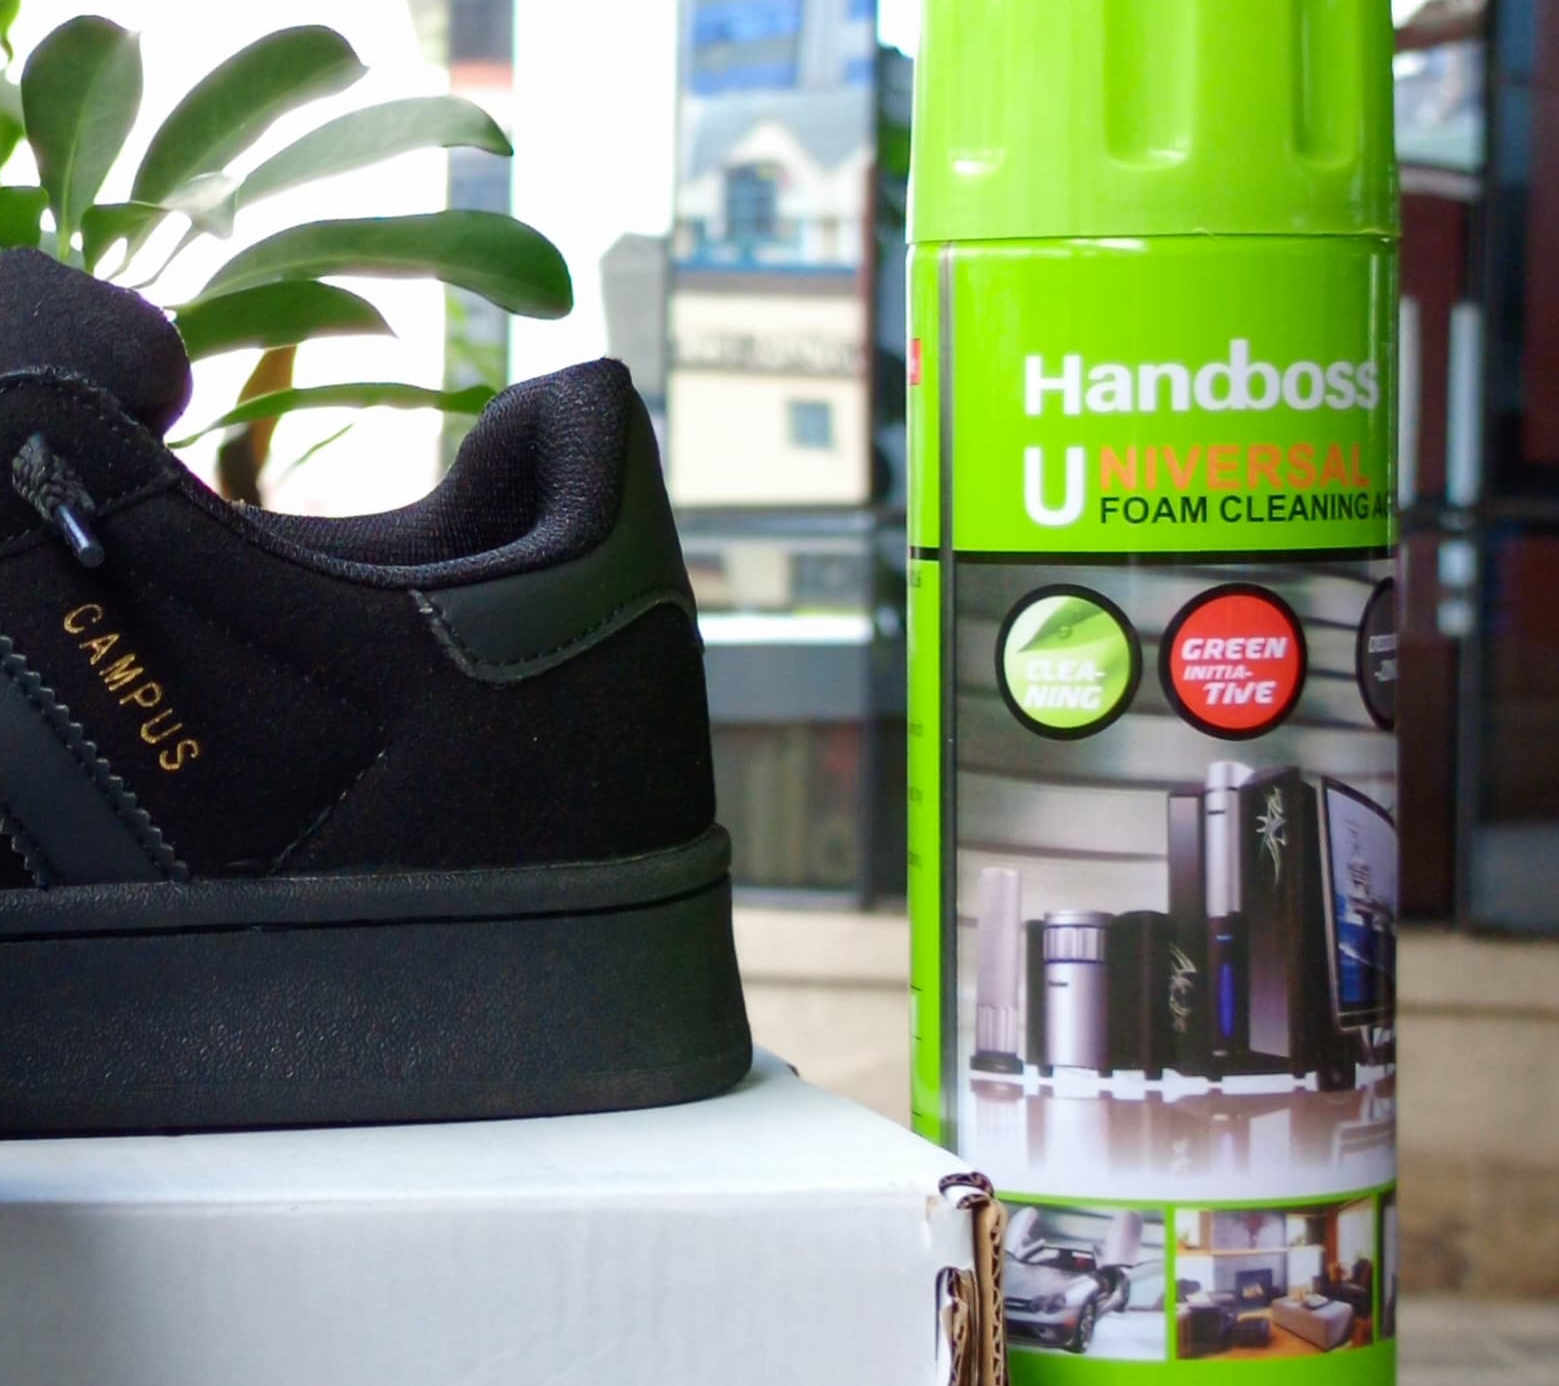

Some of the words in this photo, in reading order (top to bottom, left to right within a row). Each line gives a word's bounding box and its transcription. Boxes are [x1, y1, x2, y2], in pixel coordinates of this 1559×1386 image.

[1024, 338, 1381, 417] Handboss
[1099, 496, 1209, 525] FOAM
[1218, 491, 1370, 523] CLEANING
[1180, 636, 1288, 661] GREEN
[62, 603, 200, 771] CAMPUS
[1023, 685, 1103, 710] NING
[1204, 680, 1278, 706] TIVE
